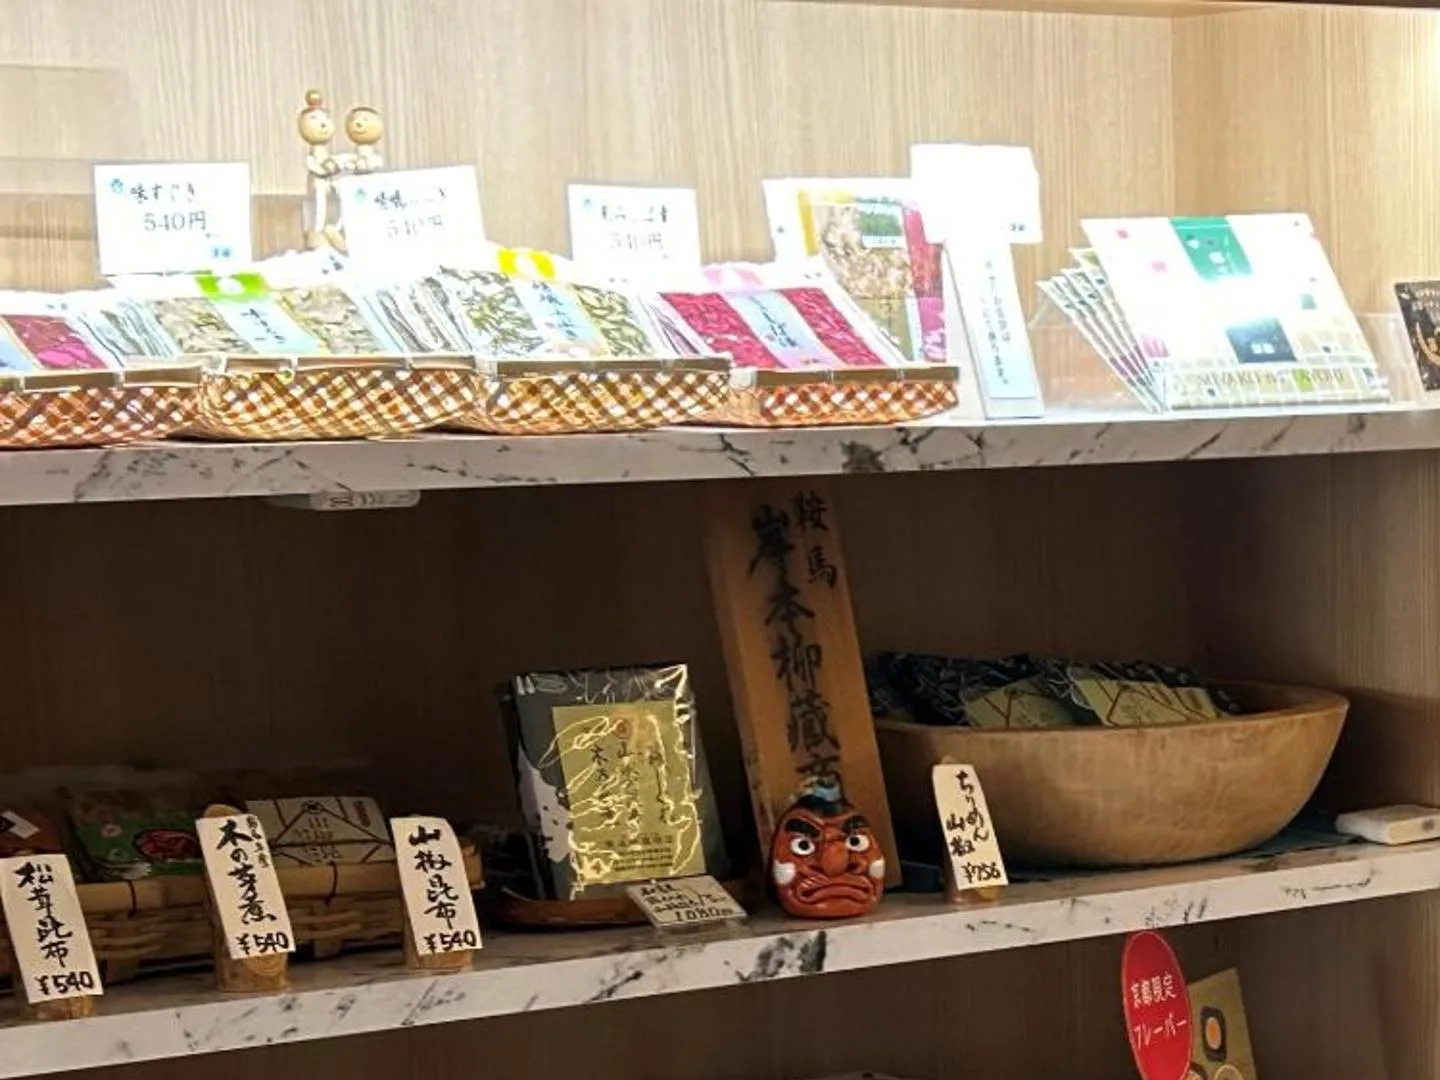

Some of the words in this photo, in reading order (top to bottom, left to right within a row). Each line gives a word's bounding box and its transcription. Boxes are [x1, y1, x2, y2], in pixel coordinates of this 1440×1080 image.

[956, 770, 989, 841] ちりめん
[960, 861, 1001, 884] ¥756
[14, 862, 73, 967] 松茸昆布
[236, 931, 289, 955] ¥540
[423, 930, 477, 954] ¥540
[35, 970, 94, 996] ¥540
[1134, 1011, 1188, 1051] フレーバー
